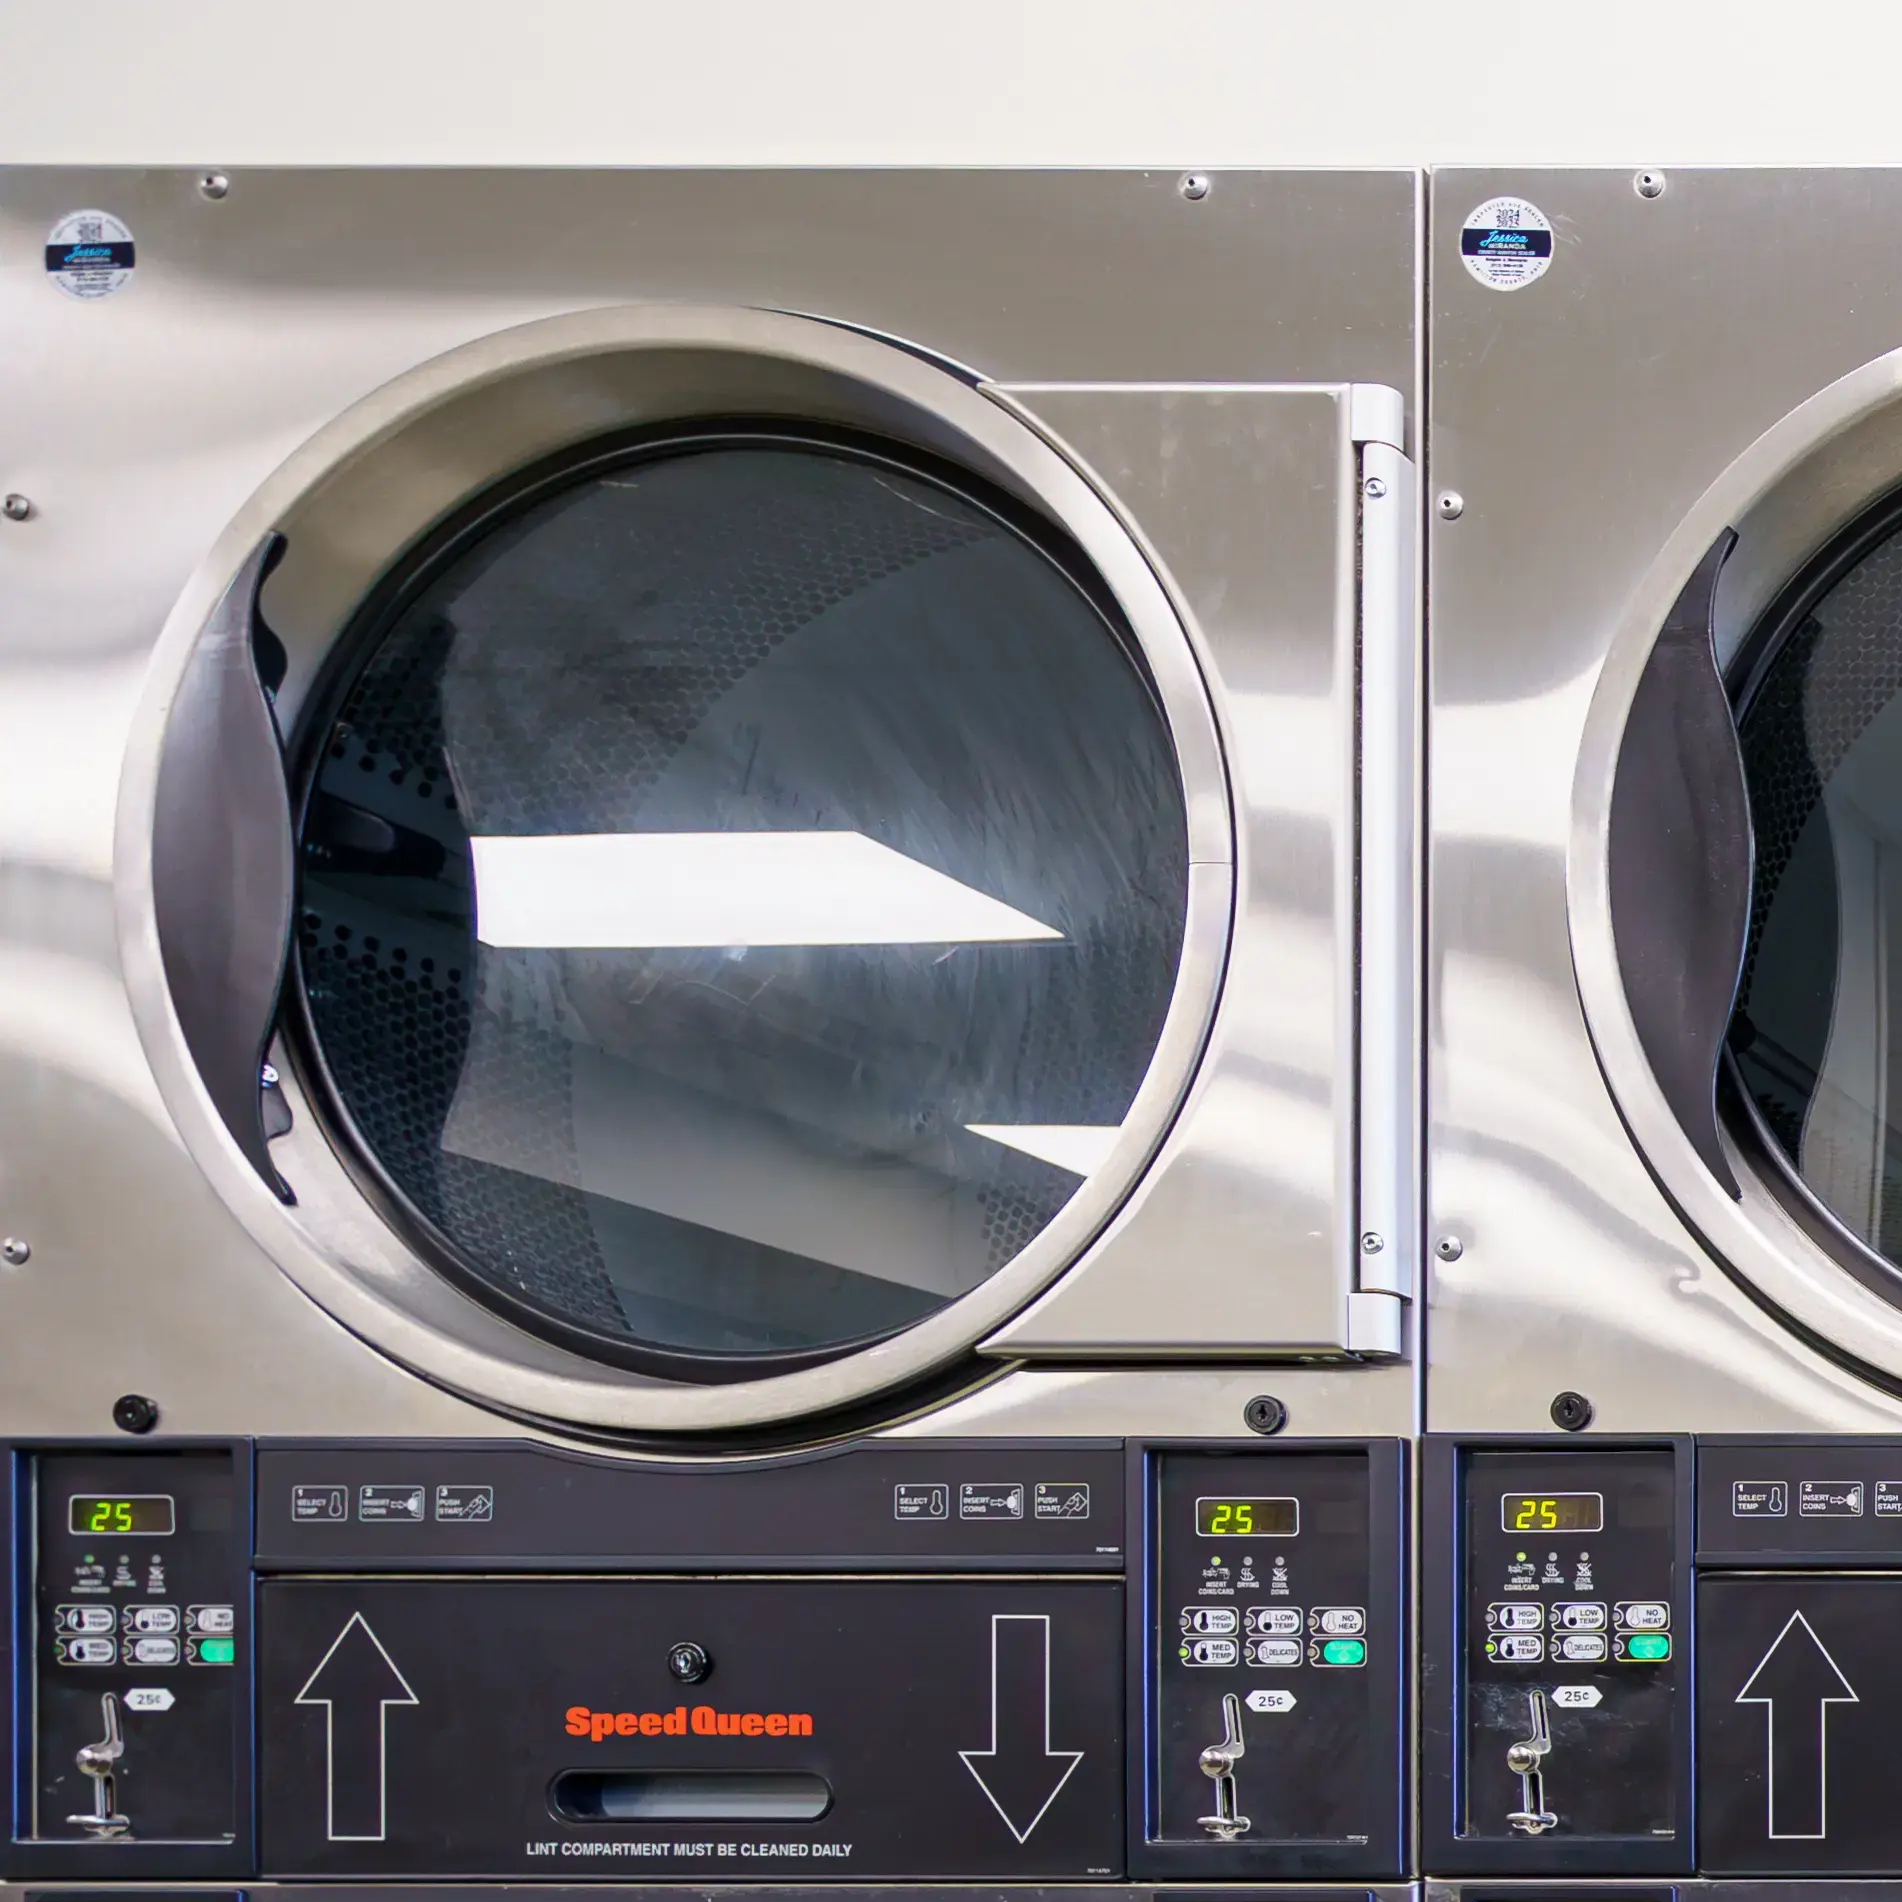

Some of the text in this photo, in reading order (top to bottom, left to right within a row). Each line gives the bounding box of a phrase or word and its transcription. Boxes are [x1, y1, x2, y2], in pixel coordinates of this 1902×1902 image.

[91, 1503, 132, 1531] 25
[1212, 1505, 1252, 1533] 25
[1516, 1501, 1557, 1528] 25
[565, 1705, 813, 1742] Speed Queen
[527, 1843, 852, 1856] LINT COMPARTMENT MUST BE CLEANED DAILY
